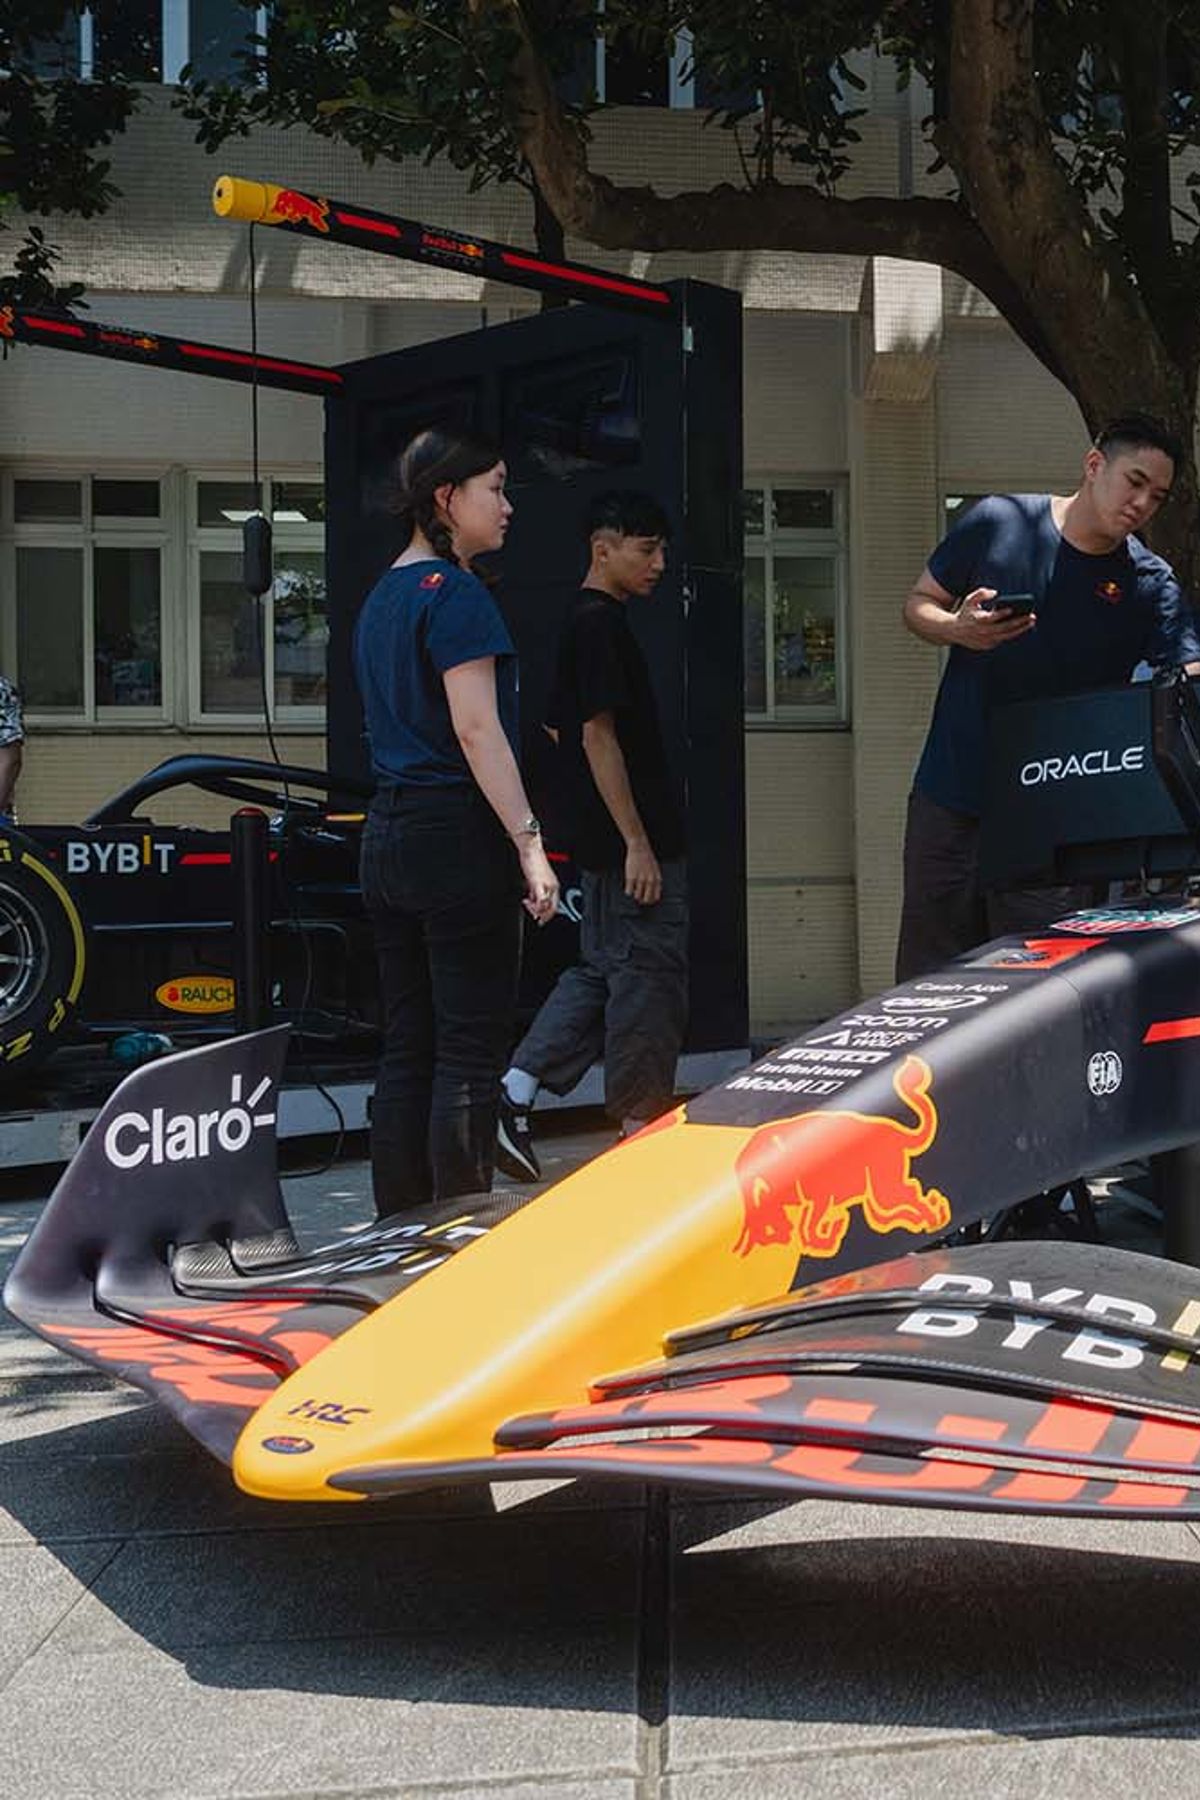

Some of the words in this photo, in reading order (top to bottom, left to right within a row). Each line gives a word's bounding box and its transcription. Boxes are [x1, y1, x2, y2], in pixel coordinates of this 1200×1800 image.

[1020, 745, 1145, 786] ORACLE
[67, 835, 175, 873] BYBIT
[842, 1014, 948, 1029] zoom
[726, 1076, 808, 1093] Mobil
